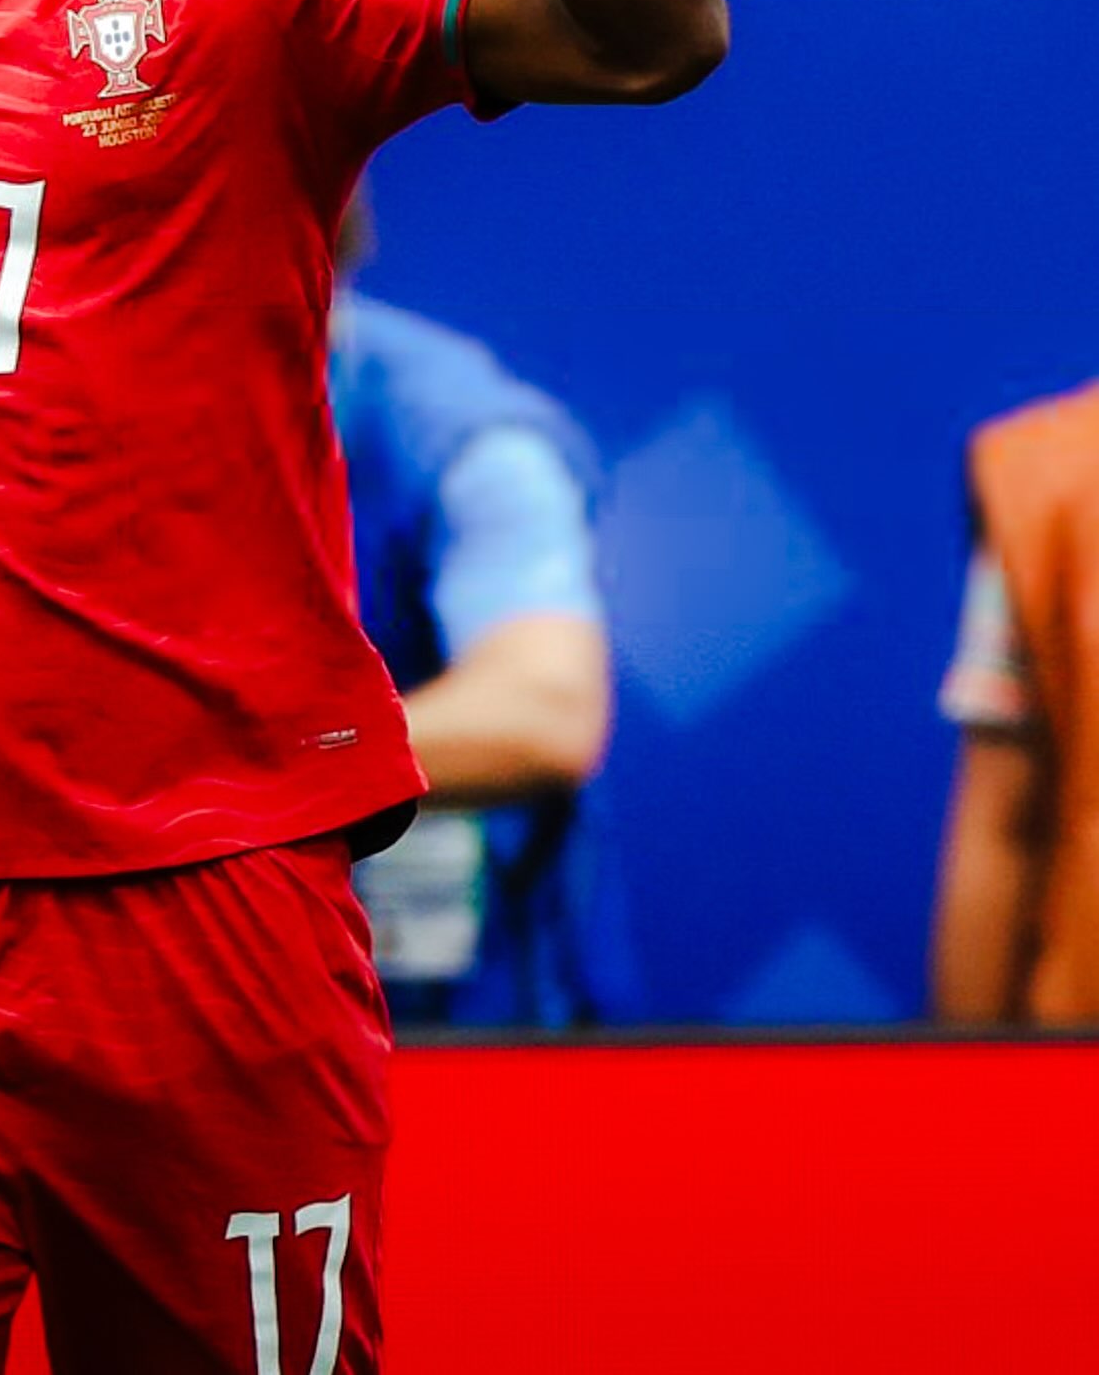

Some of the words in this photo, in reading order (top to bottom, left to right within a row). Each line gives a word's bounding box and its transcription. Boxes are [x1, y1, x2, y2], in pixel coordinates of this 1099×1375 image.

[80, 122, 98, 137] 23
[98, 123, 157, 148] HOUSTON
[225, 1192, 350, 1375] 17
